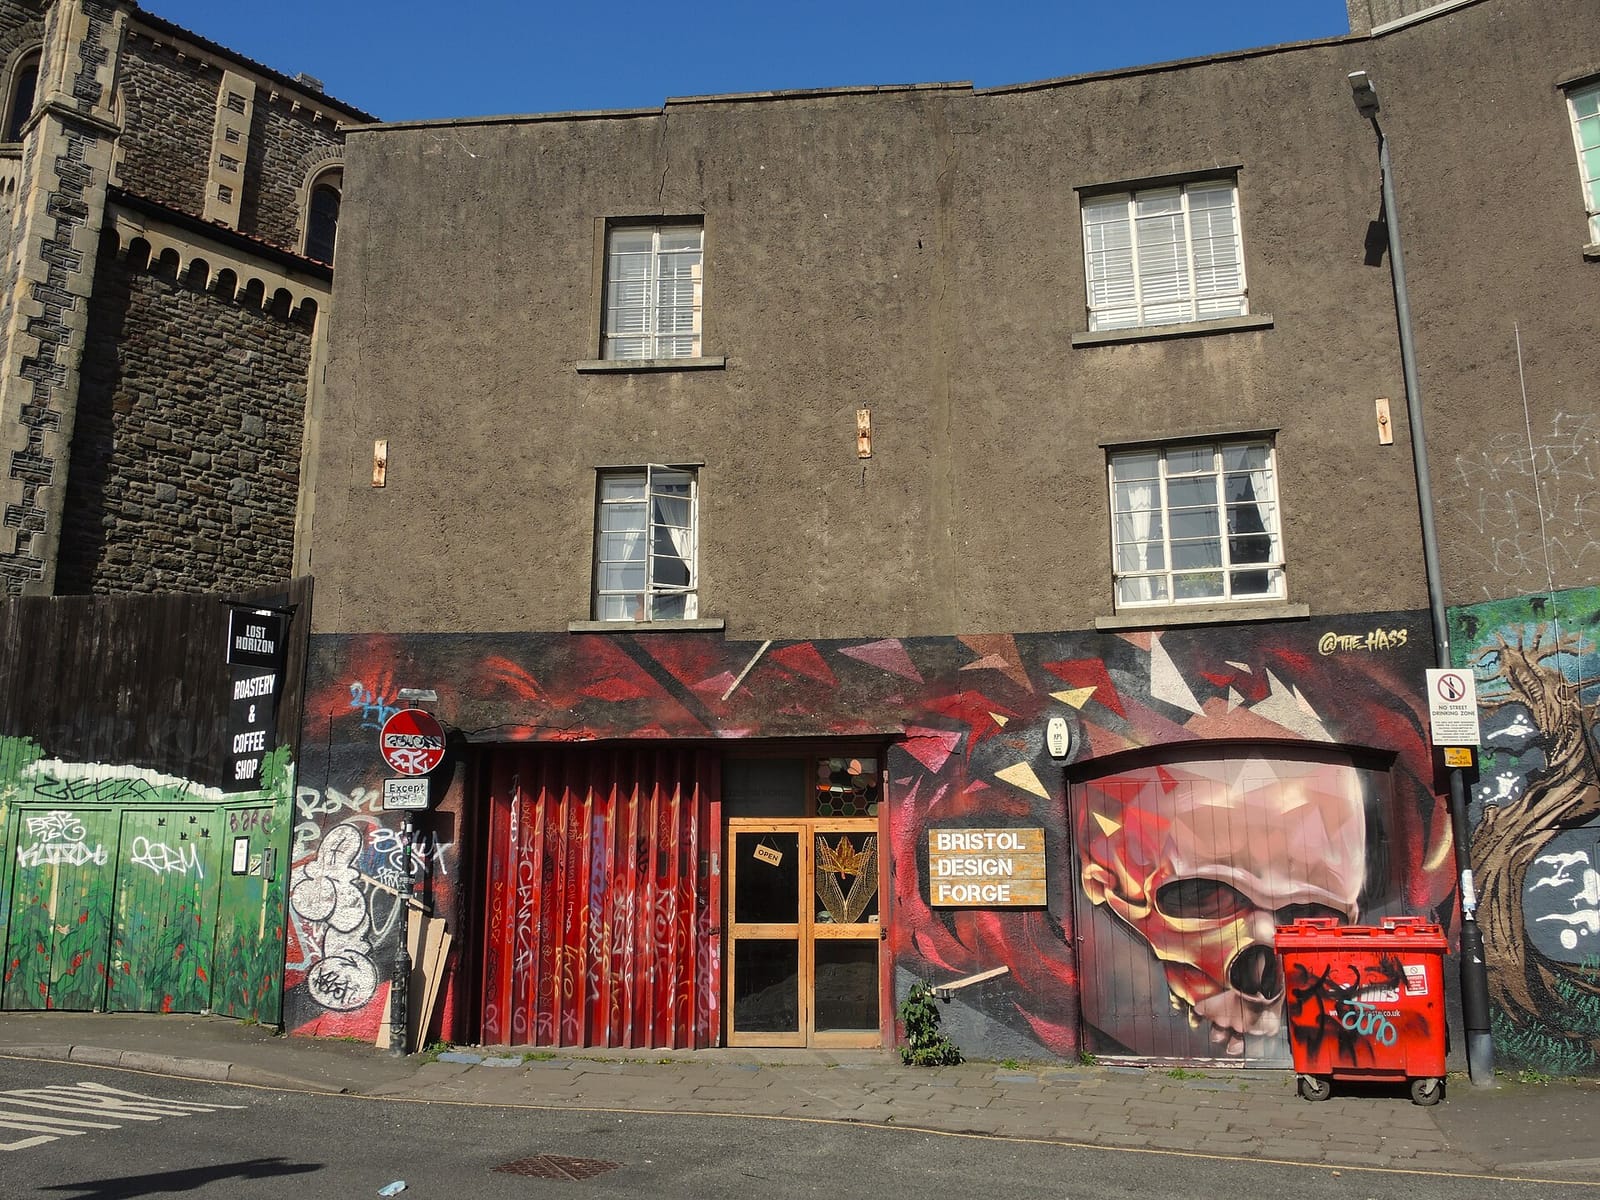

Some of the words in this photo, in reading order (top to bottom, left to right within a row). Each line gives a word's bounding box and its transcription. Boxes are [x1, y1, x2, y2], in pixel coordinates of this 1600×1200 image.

[246, 624, 266, 639] LOST
[235, 635, 274, 654] HORIZON
[233, 674, 276, 700] ROASTERY
[248, 704, 256, 723] &
[233, 730, 266, 754] COFFEE
[235, 759, 258, 780] SHOP
[389, 783, 425, 794] Except
[937, 833, 1026, 851] BRISTOL
[758, 849, 779, 862] OPEN
[938, 858, 1013, 876] DESIGN
[938, 884, 1011, 902] FORGE
